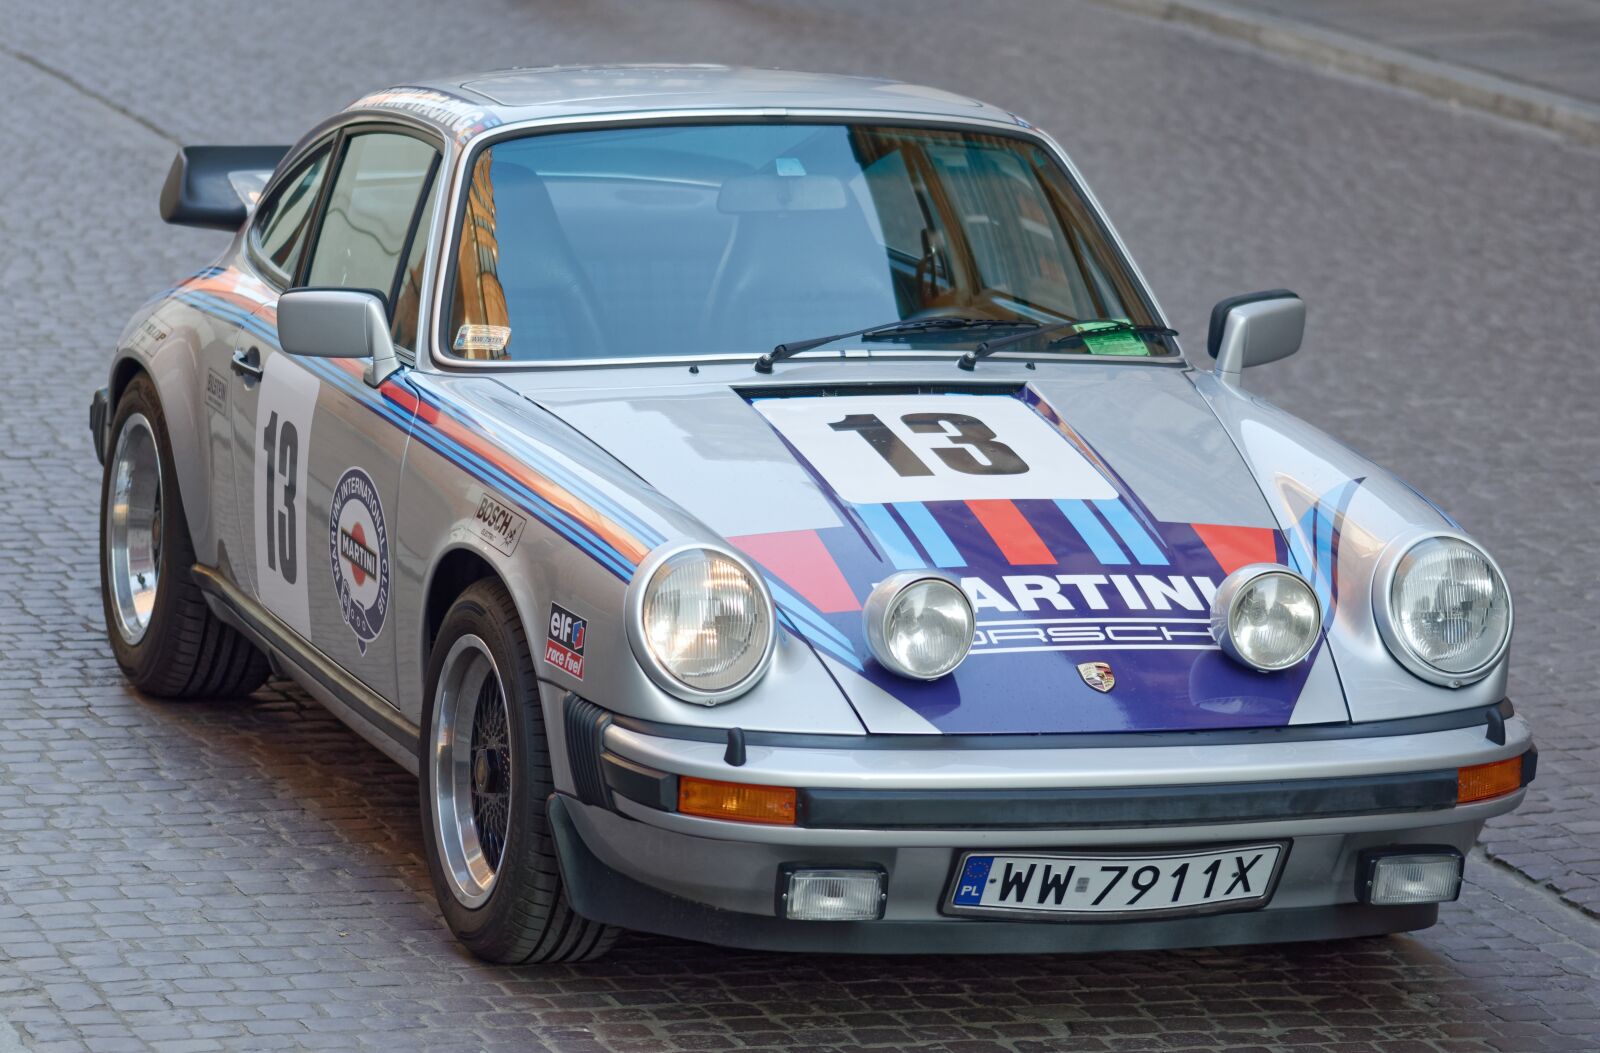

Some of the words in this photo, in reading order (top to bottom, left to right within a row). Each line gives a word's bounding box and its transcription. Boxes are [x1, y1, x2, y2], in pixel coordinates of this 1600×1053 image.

[827, 412, 1030, 477] 13
[264, 410, 298, 585] 13
[476, 498, 513, 536] BOSCH
[331, 493, 342, 582] MARTINI
[341, 477, 386, 552] INTERNATIONAL
[378, 558, 388, 615] CLUB
[342, 533, 376, 576] MARTINI
[871, 573, 1218, 613] ARTINI
[551, 612, 573, 642] elf
[547, 647, 565, 665] race
[565, 652, 582, 675] fuel
[960, 886, 979, 897] PL
[999, 862, 1076, 905] WW
[1091, 854, 1263, 906] 7911X
